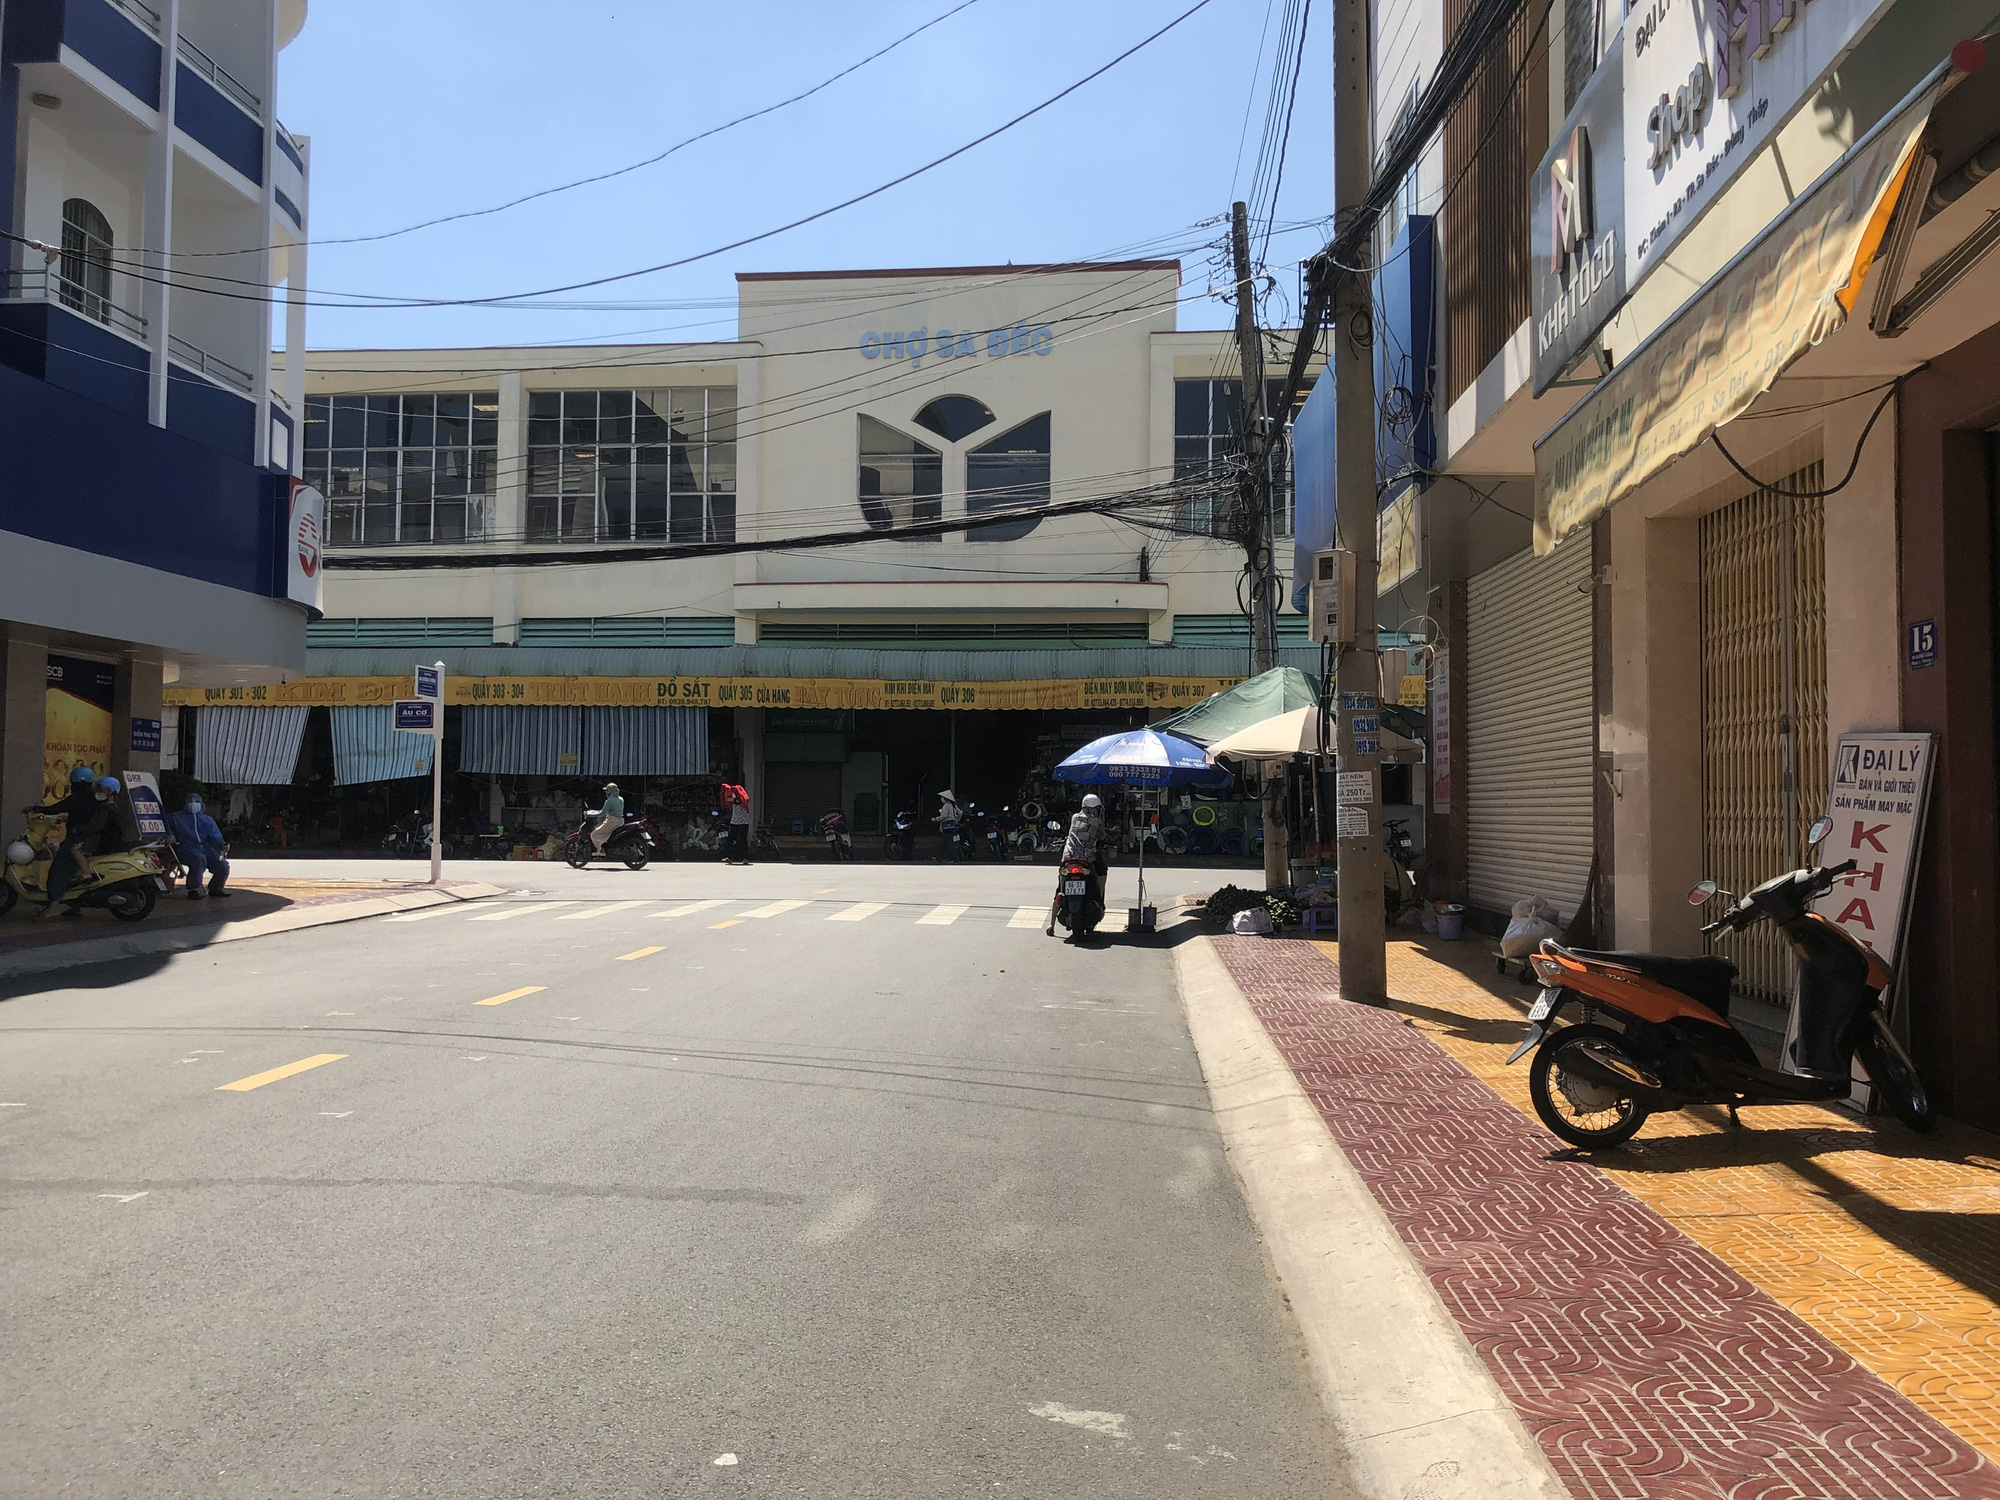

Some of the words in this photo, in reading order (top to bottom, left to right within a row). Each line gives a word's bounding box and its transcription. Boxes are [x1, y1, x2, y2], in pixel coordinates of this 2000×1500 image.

[859, 326, 928, 368] CHỢ
[936, 329, 977, 358] SA
[1912, 624, 1933, 653] 15
[46, 665, 63, 677] SCB
[229, 686, 244, 700] 301
[251, 686, 267, 700] 302
[274, 682, 346, 702] KIM
[492, 683, 506, 699] 303
[511, 683, 524, 699] 304
[657, 676, 678, 697] ĐỒ
[683, 676, 711, 697] SẮT
[740, 685, 753, 701] 305
[1192, 685, 1206, 698] 307
[961, 687, 975, 703] 306
[1863, 749, 1893, 775] ĐẠI
[1898, 744, 1920, 771] LÝ
[1858, 777, 1872, 790] BÁN
[1874, 777, 1882, 792] VÀ
[1835, 793, 1852, 808] SẢN
[1853, 794, 1876, 811] PHẨM
[1878, 800, 1895, 813] MAY
